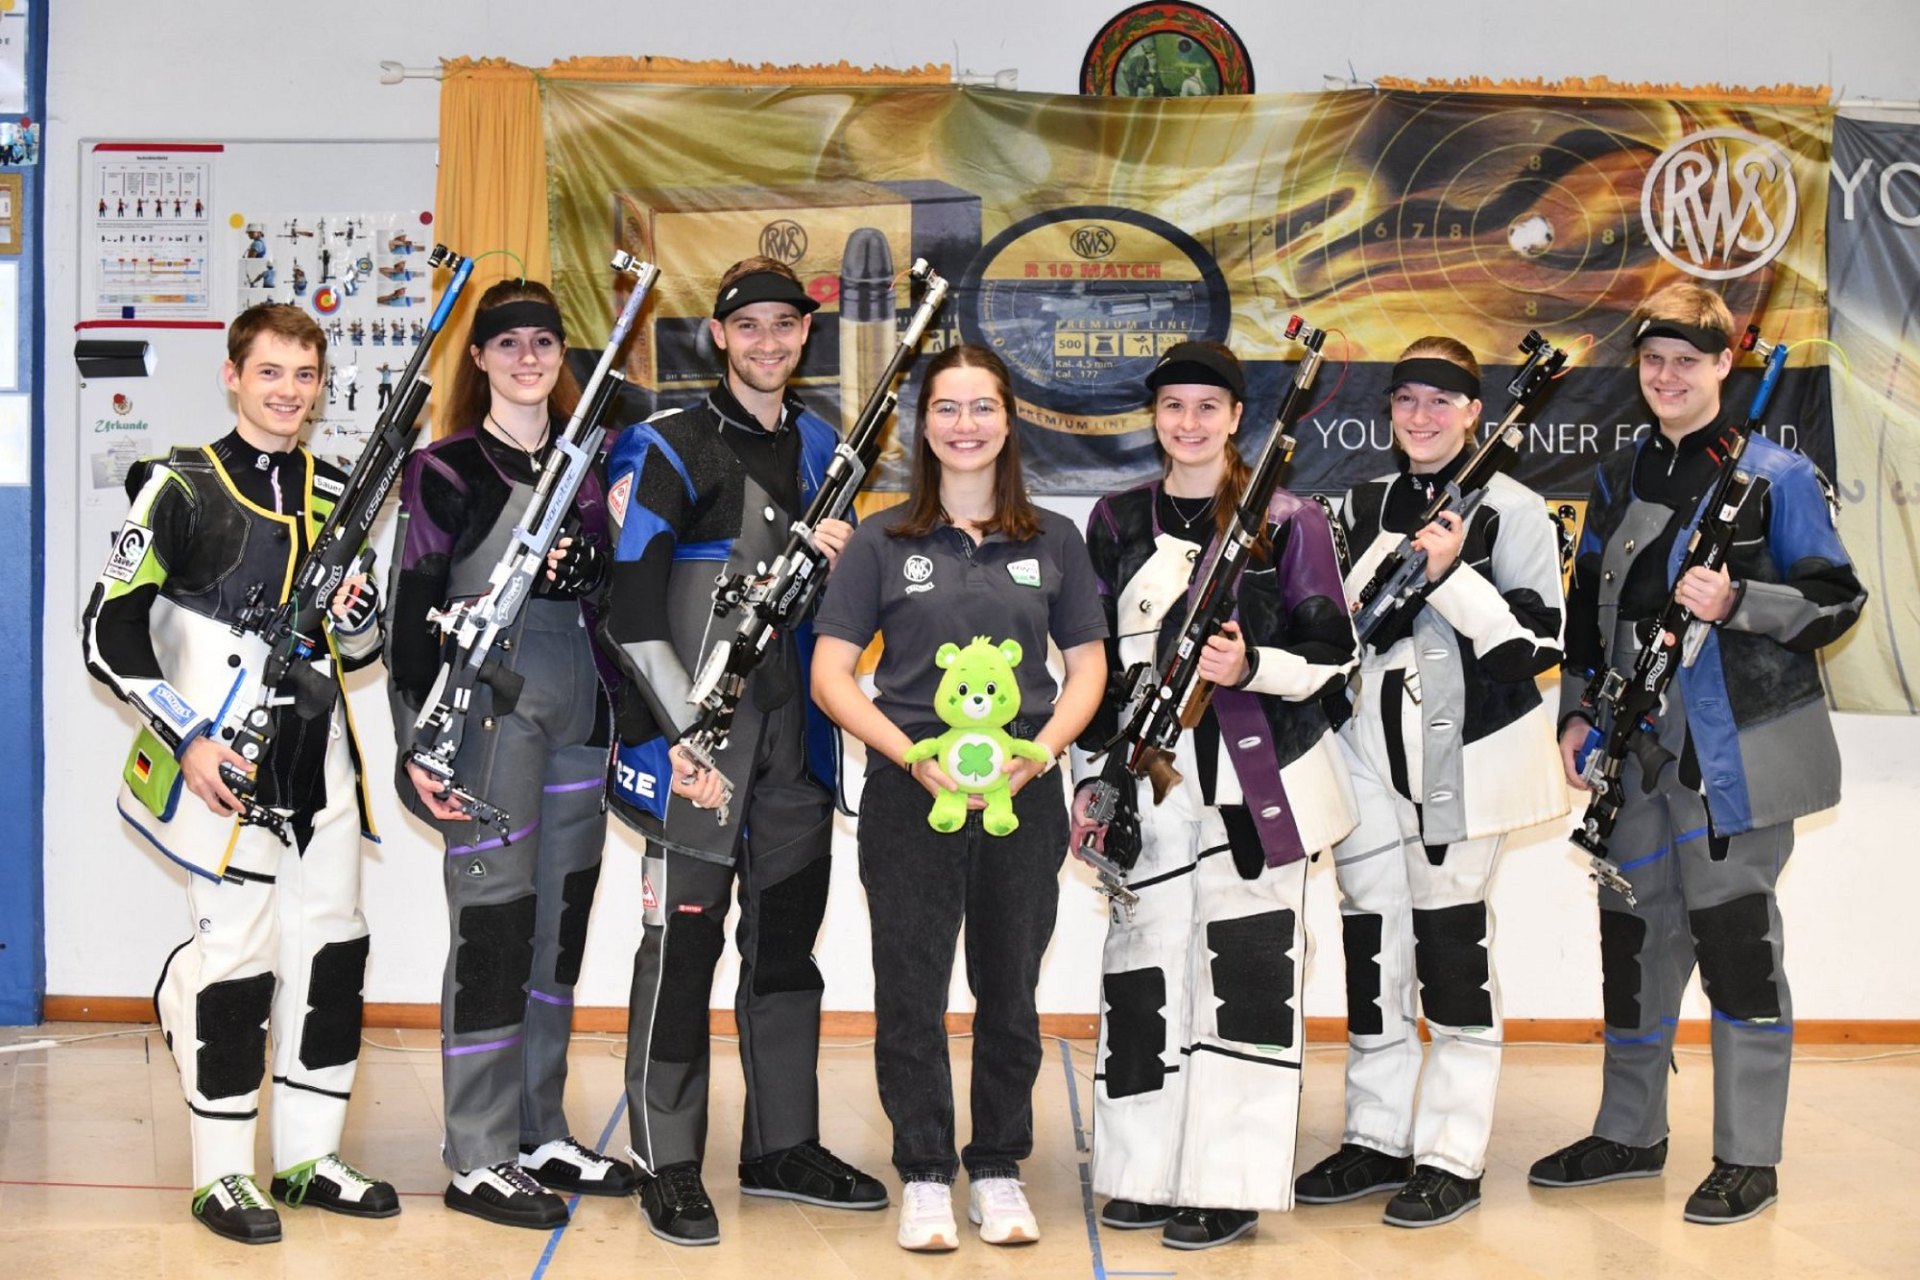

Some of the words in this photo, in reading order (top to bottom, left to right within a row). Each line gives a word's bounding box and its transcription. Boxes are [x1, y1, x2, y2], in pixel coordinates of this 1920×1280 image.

[1529, 154, 1542, 171] 8
[1661, 144, 1777, 266] RWS
[1072, 226, 1112, 258] RWS
[1374, 222, 1388, 238] 6
[1412, 222, 1425, 239] 7
[1450, 223, 1462, 240] 8
[1602, 228, 1615, 244] 8
[764, 224, 801, 264] RWS
[1024, 263, 1039, 279] R
[1050, 262, 1074, 279] 10
[1080, 262, 1162, 279] MATCH
[1056, 319, 1138, 330] PREMIUM
[1149, 319, 1189, 330] LINE
[1059, 339, 1082, 350] 500
[316, 477, 343, 494] Sauer
[906, 557, 931, 581] RWS
